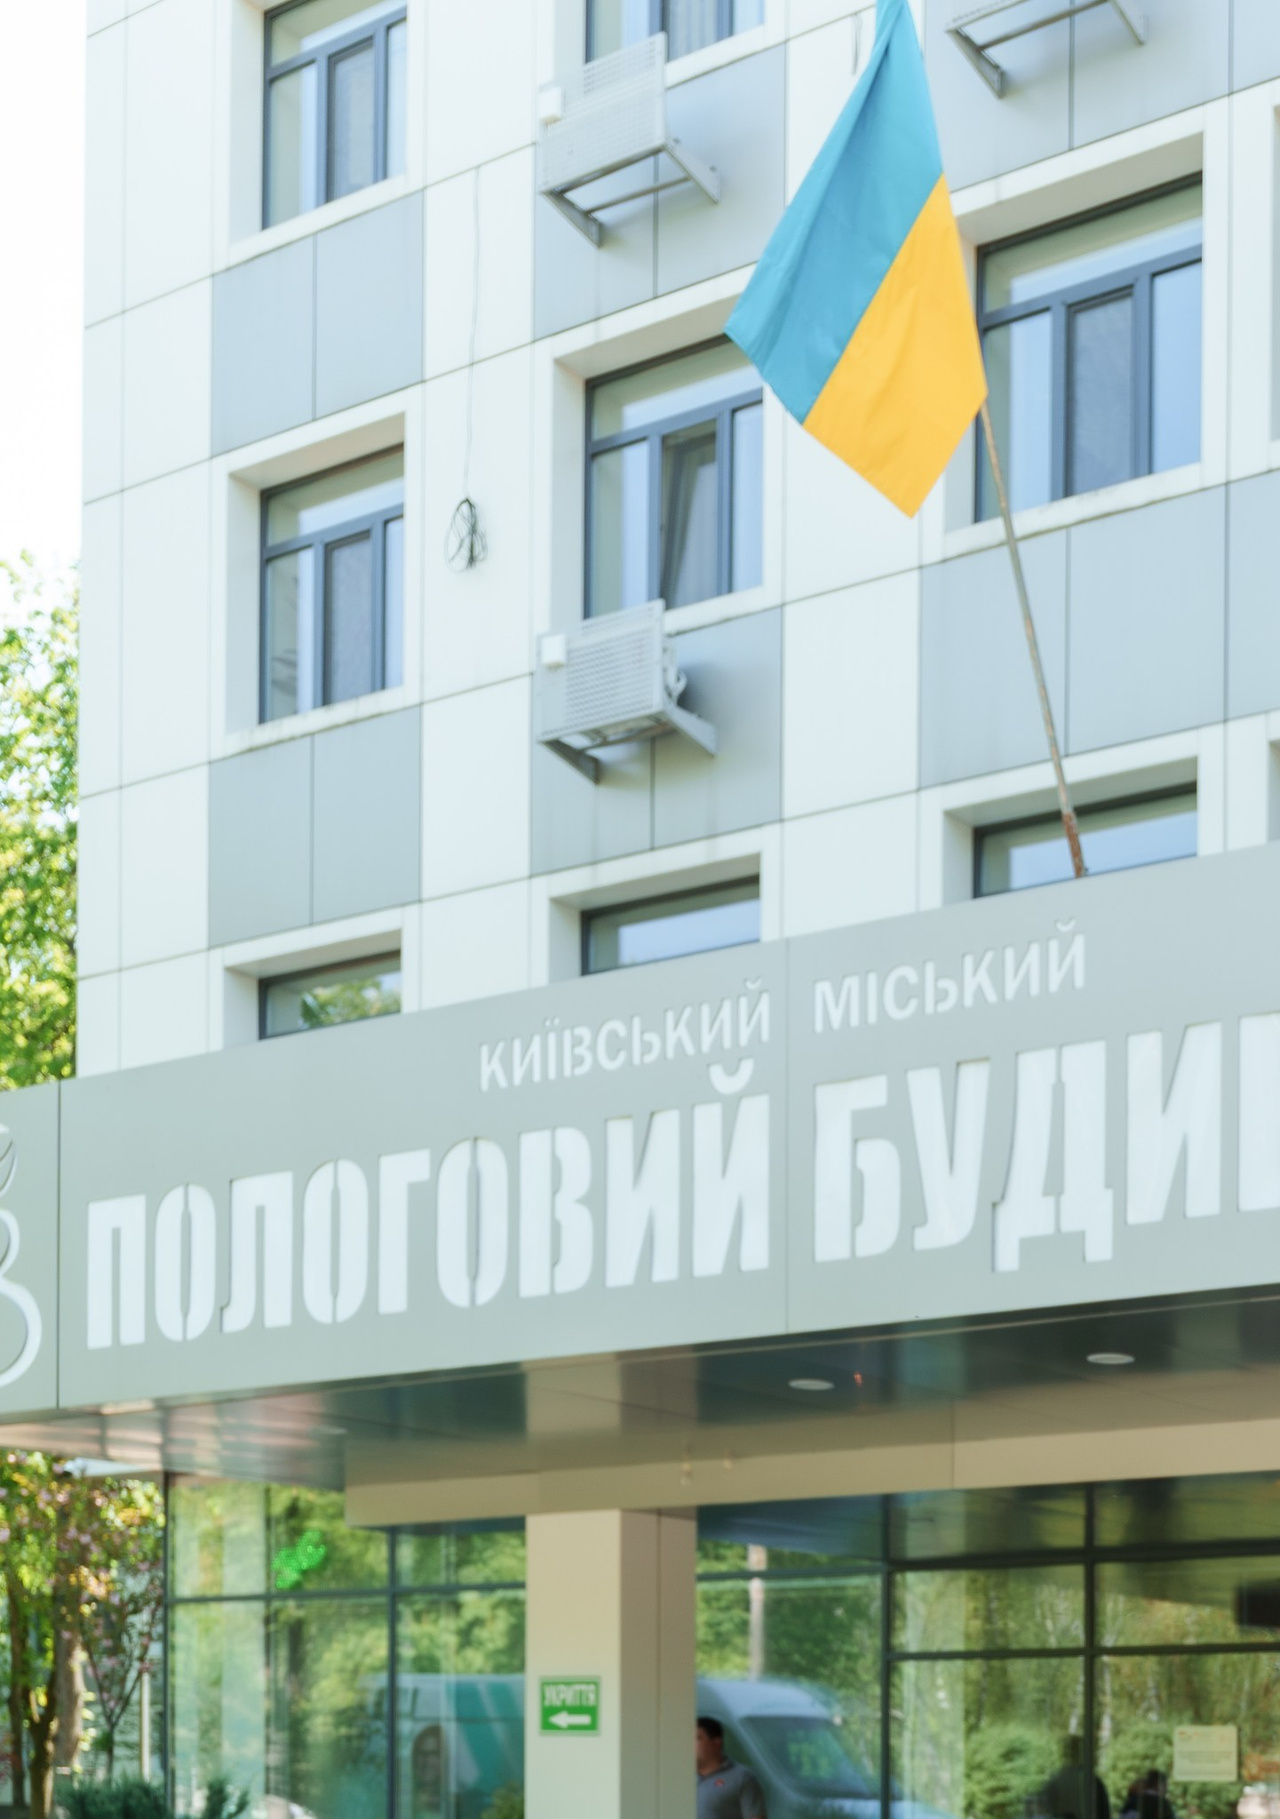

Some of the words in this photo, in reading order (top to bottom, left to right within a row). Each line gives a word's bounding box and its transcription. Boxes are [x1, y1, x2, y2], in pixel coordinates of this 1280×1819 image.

[479, 977, 771, 1093] КИЇВСЬКИЙ
[813, 917, 1087, 1034] МІСЬКИЙ
[86, 1057, 771, 1350] ПОЛОГОВИЙ
[545, 1684, 596, 1707] УКРИТТЯ
